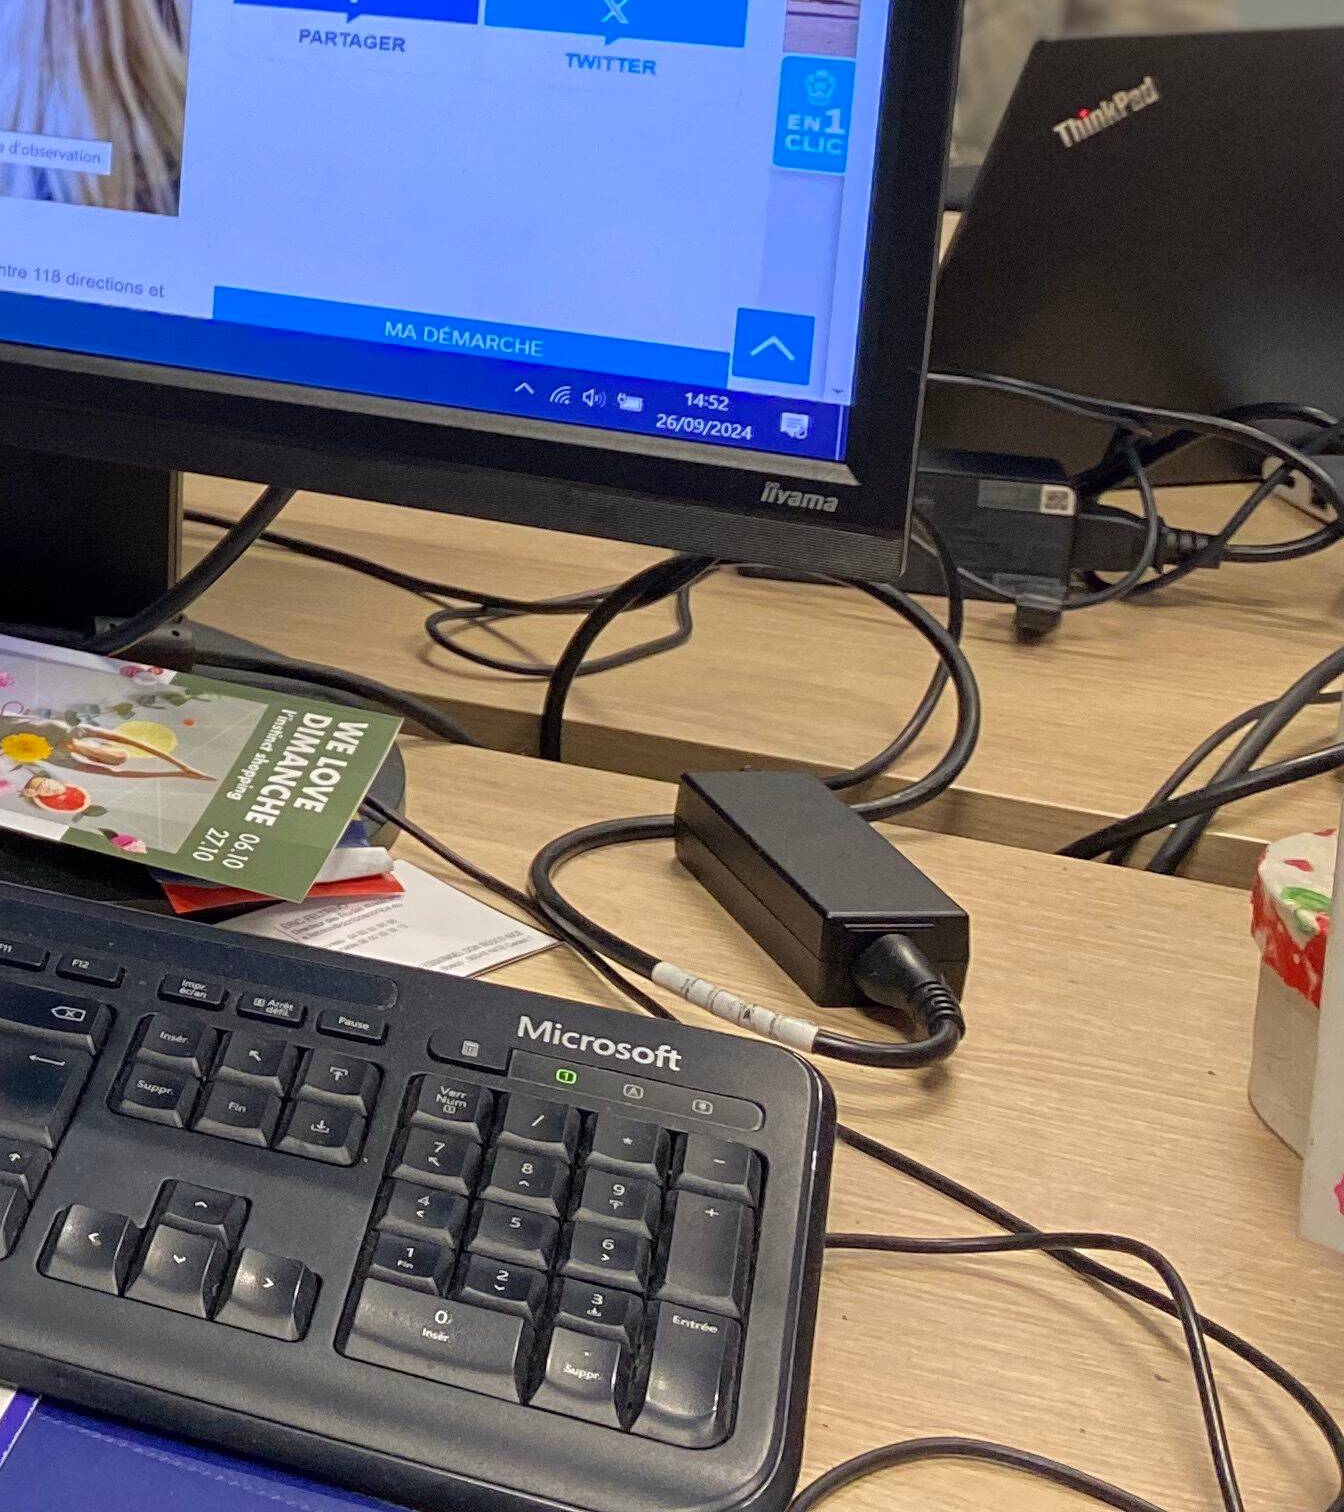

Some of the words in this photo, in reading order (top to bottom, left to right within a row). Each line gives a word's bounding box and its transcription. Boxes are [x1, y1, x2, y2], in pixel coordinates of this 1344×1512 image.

[298, 28, 406, 53] PARTAGER
[565, 52, 657, 76] TWITTER
[786, 112, 820, 131] EN
[823, 107, 846, 135] 1
[1052, 75, 1160, 149] ThinkPad
[9, 141, 102, 165] d'observation
[784, 133, 843, 155] CLIC
[32, 266, 61, 284] 118
[65, 269, 144, 297] directions
[148, 280, 166, 299] et
[384, 319, 417, 341] MA
[423, 322, 544, 358] DÉMARCHE
[684, 390, 730, 412] 14:52
[655, 412, 752, 441] 26/09/2024
[760, 481, 839, 514] iiyama
[325, 721, 369, 755] WE
[226, 752, 269, 801] shopping
[244, 712, 333, 826] DIMANCHE
[293, 756, 348, 813] LOVE
[192, 827, 230, 863] 27.10
[222, 833, 261, 870] 06.10
[71, 959, 90, 970] F12
[338, 1016, 370, 1031] Pause
[516, 1014, 683, 1072] Microsoft
[435, 1094, 468, 1110] Num
[440, 1085, 467, 1099] Verr
[227, 1101, 247, 1114] Fin
[432, 1141, 446, 1154] 7
[520, 1162, 534, 1176] 8
[416, 1195, 430, 1207] 4
[612, 1184, 625, 1197] 9
[509, 1216, 521, 1229] 5
[601, 1238, 615, 1251] 6
[496, 1269, 509, 1282] 2
[590, 1293, 604, 1306] 3
[672, 1314, 718, 1334] Entrée
